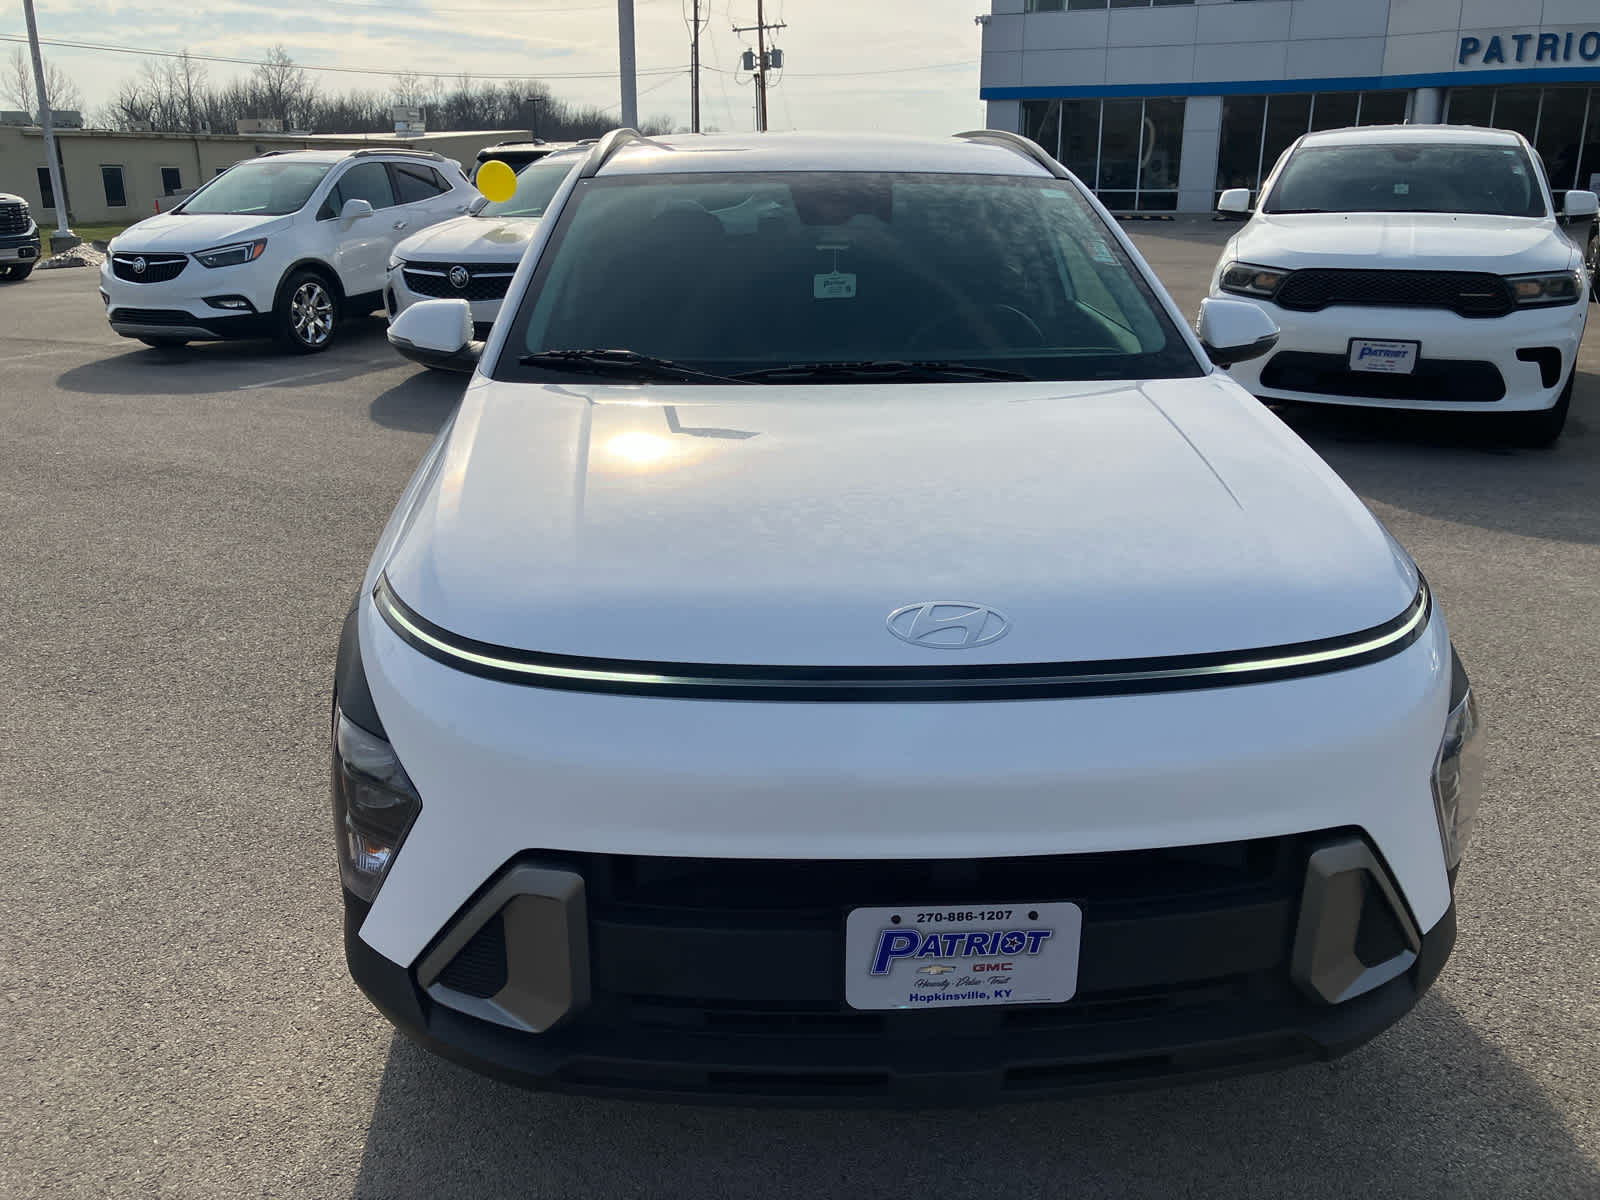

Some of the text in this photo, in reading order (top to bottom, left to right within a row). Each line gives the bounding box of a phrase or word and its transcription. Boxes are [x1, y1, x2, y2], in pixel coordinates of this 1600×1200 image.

[1458, 31, 1600, 65] PATRIO
[917, 910, 1013, 923] 270-886-1207
[871, 929, 1052, 976] PATRIOT
[973, 962, 1013, 972] GMC
[909, 988, 1012, 1003] Hopkinsville, KY
